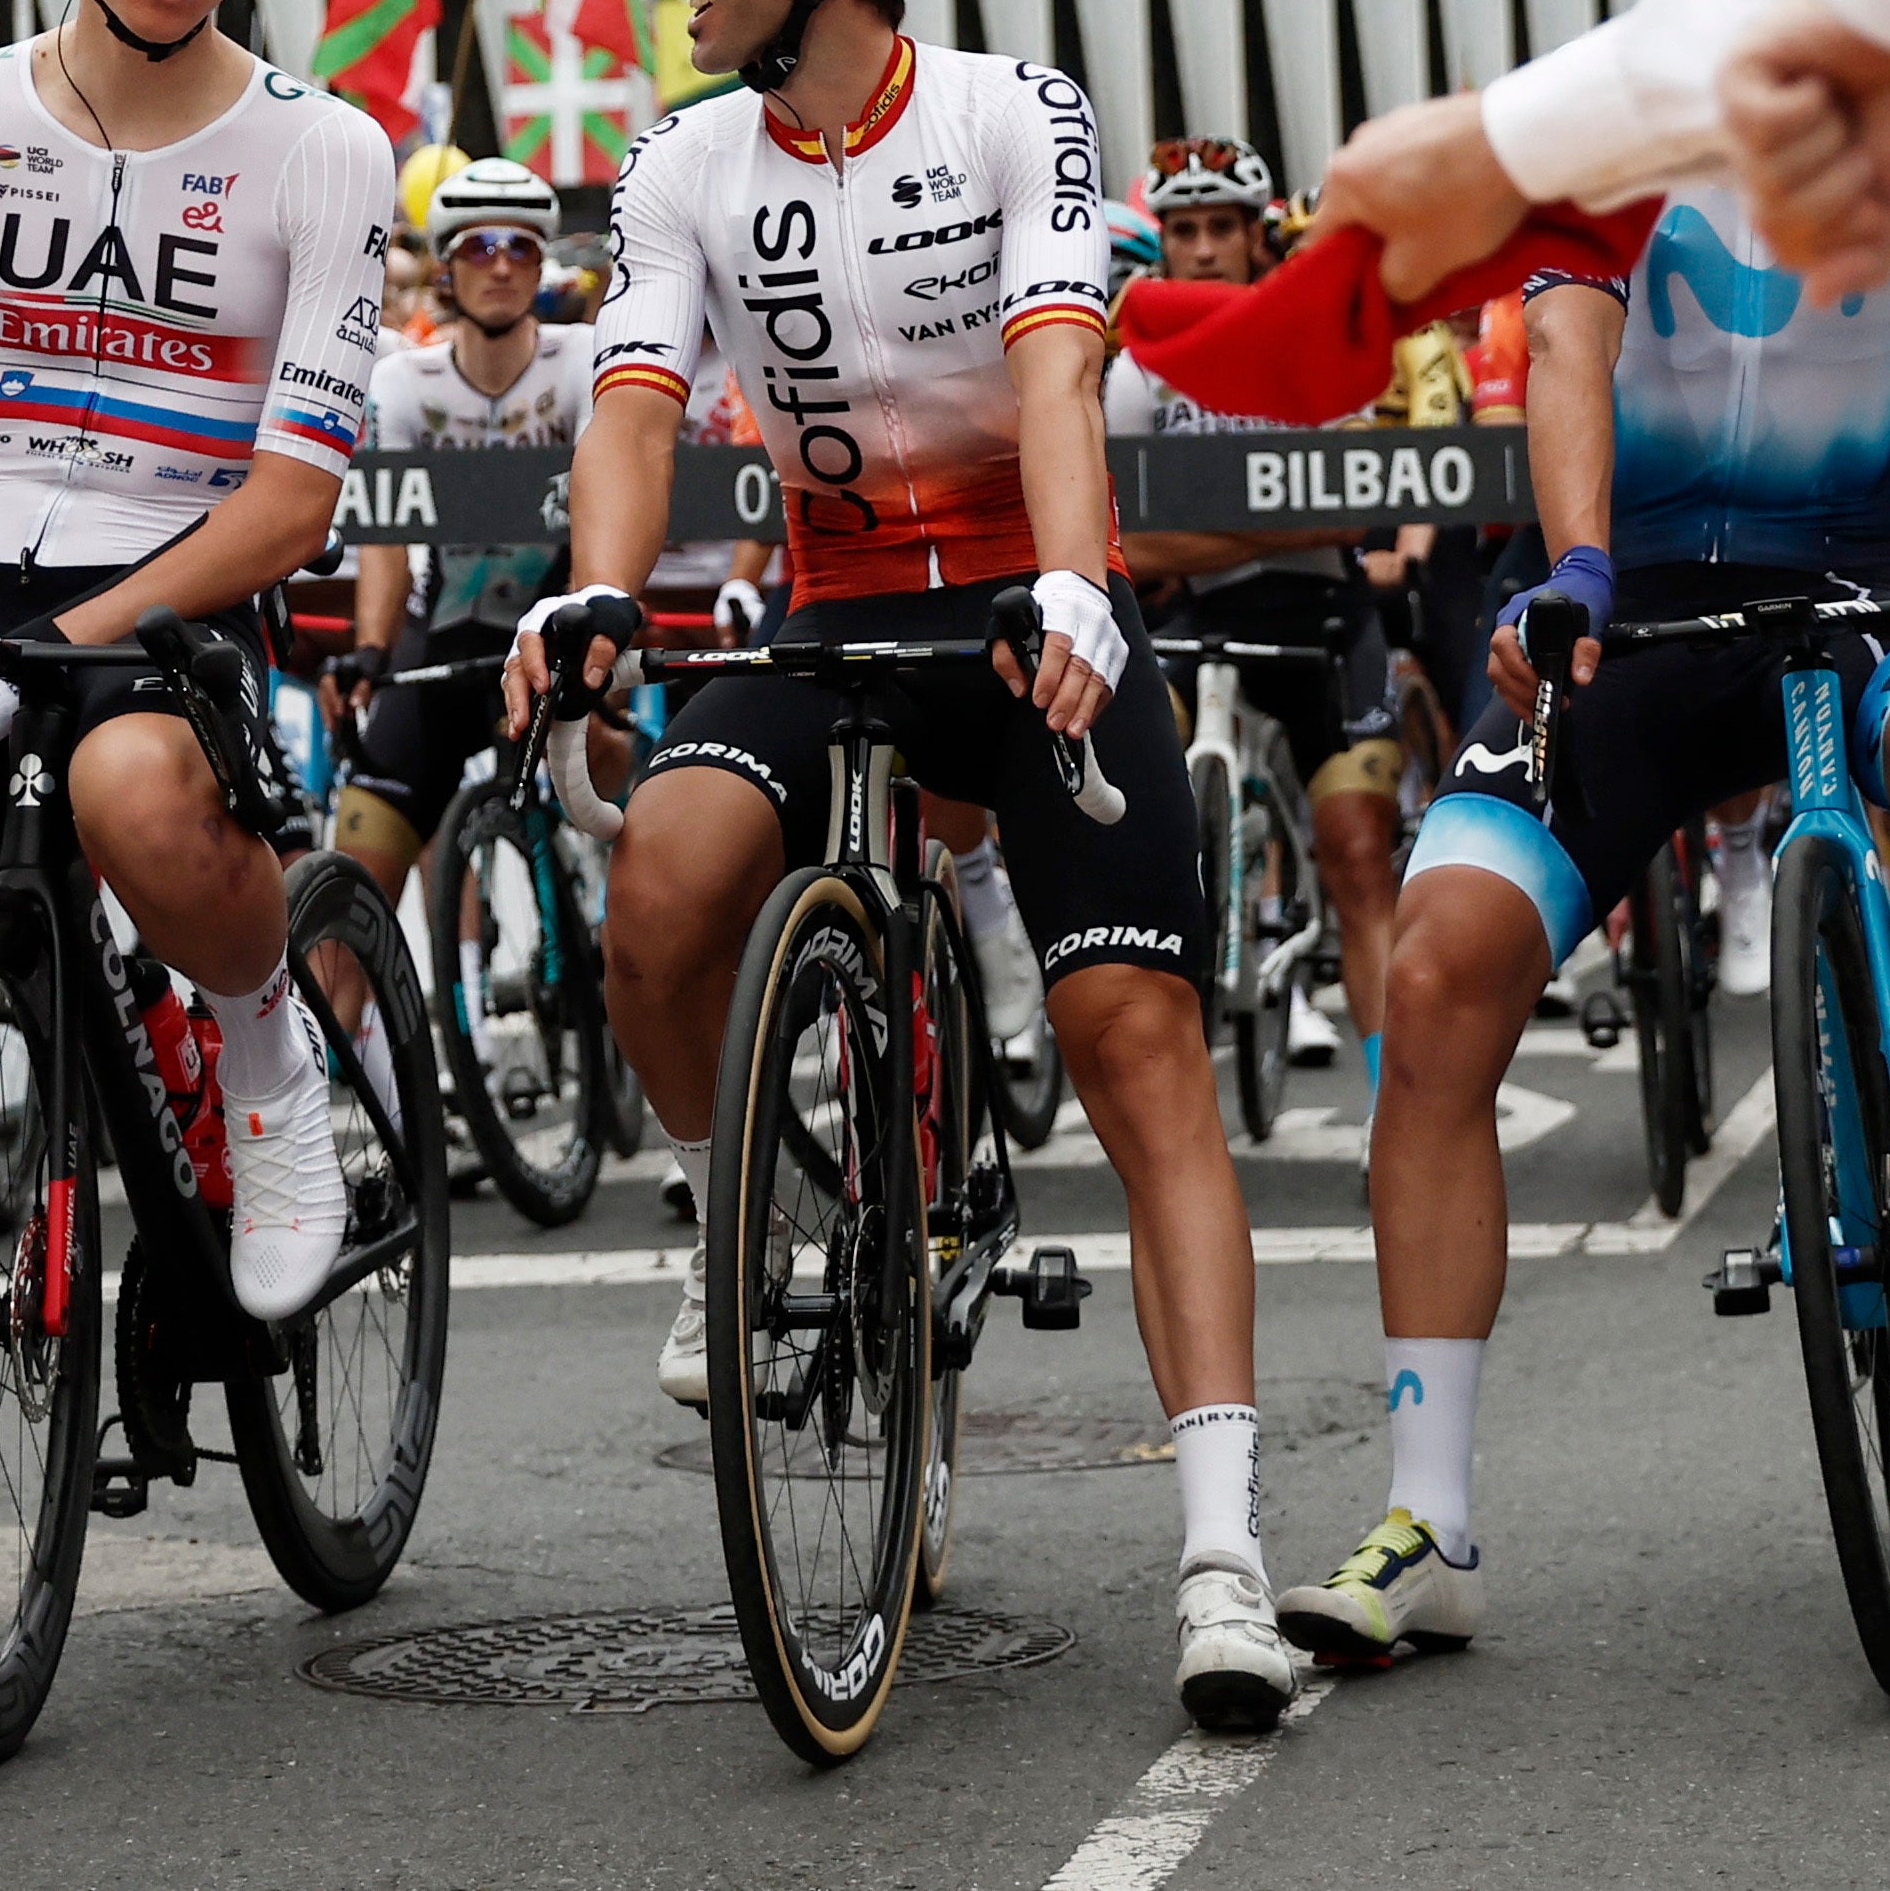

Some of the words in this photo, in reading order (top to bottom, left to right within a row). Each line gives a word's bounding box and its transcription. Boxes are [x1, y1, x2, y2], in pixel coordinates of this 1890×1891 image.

[26, 146, 49, 157] UCI
[26, 155, 64, 169] WORLD
[26, 162, 54, 175] TEAM
[926, 164, 950, 179] UCI
[928, 173, 968, 191] WORLD
[10, 187, 60, 203] PISSEI
[931, 187, 963, 204] TEAM
[867, 208, 1004, 256] LOOK
[898, 318, 956, 343] VAN
[278, 360, 366, 408] Emirates
[1245, 445, 1476, 512] BILBAO
[686, 646, 772, 663] LOOK
[648, 740, 789, 805] CORIMA
[848, 769, 864, 853] LOOK
[1043, 924, 1184, 972] CORIMA
[90, 896, 198, 1200] COLNAGO
